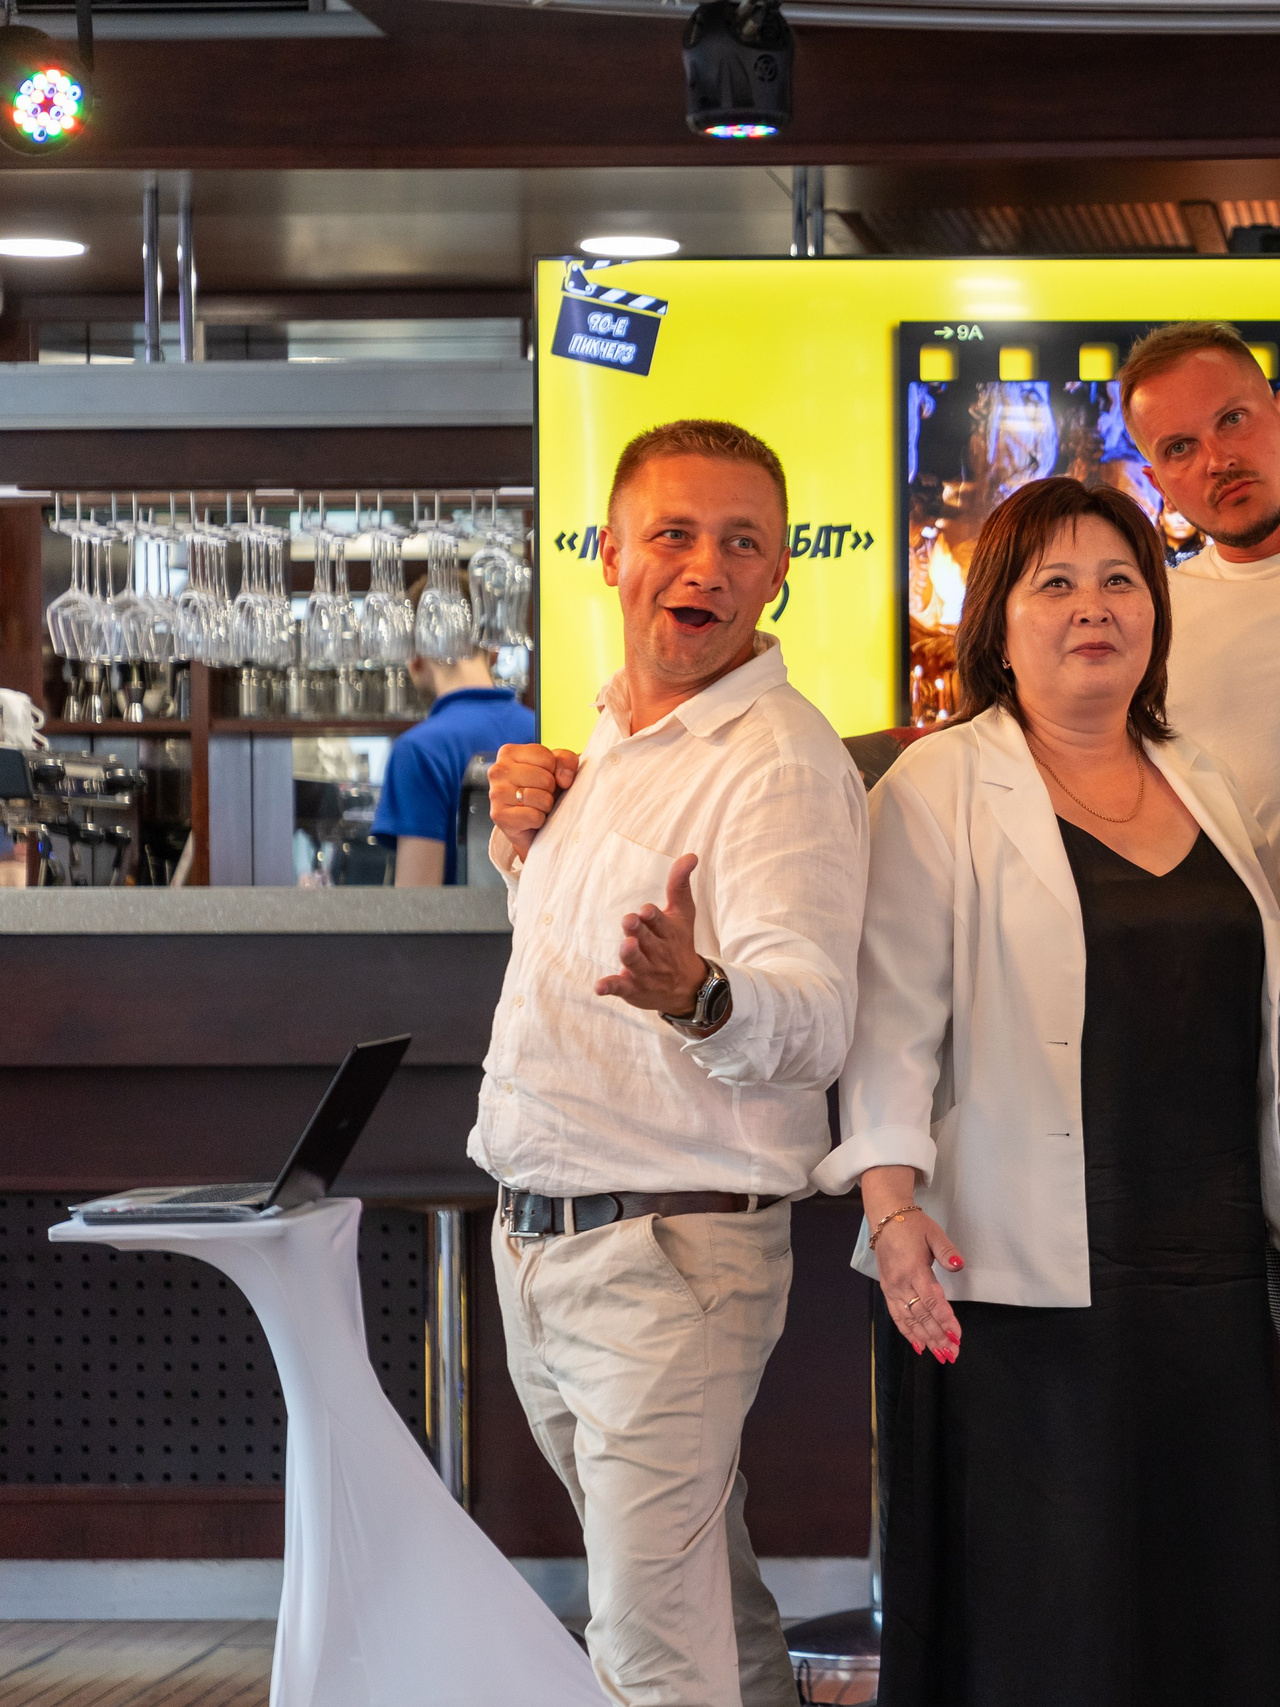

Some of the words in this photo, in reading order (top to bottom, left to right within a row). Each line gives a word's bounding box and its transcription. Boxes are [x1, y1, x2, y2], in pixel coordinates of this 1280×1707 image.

[587, 311, 630, 337] 90-Е
[957, 324, 984, 341] 9A
[568, 333, 637, 365] ПИКЧЕРЗ
[787, 523, 875, 559] БАТ»
